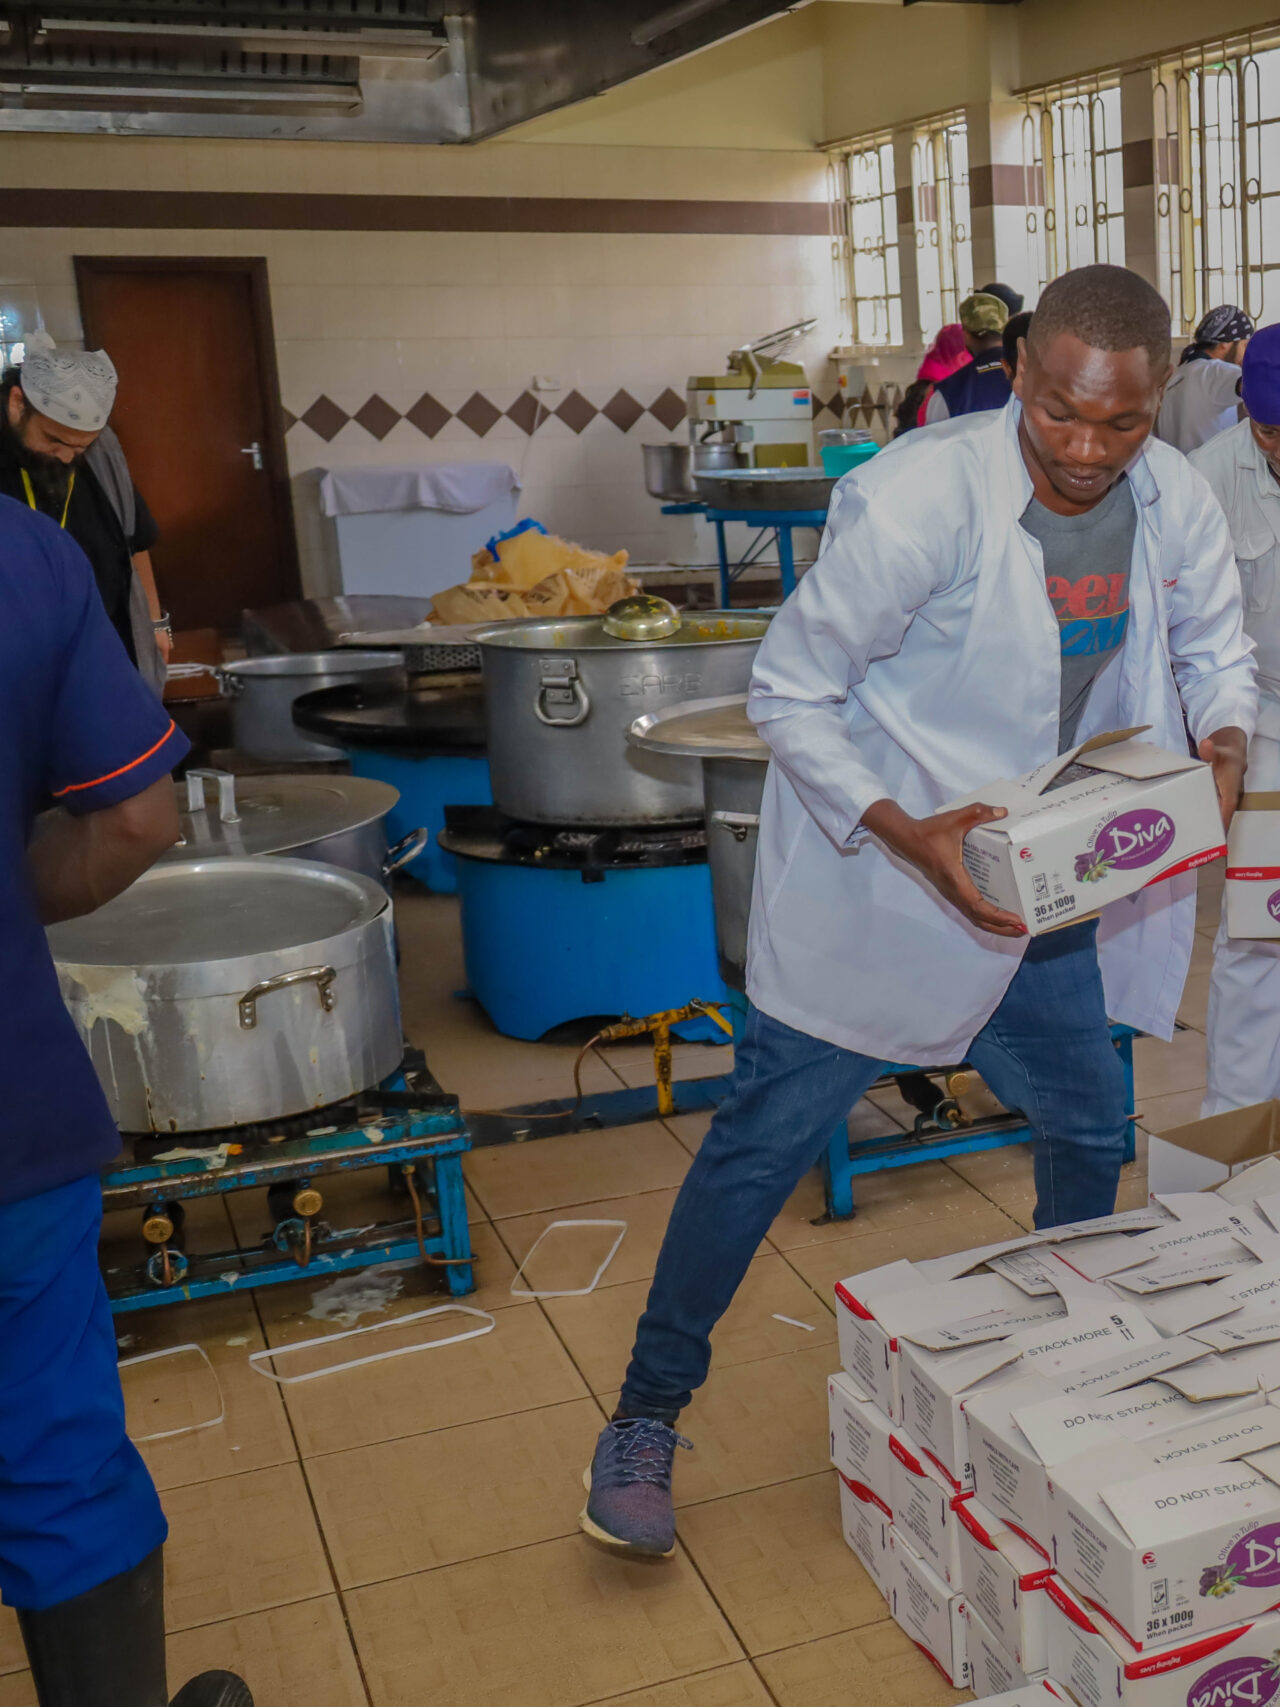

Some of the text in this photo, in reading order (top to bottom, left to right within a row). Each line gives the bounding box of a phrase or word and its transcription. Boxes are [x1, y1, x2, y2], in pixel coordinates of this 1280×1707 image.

[1102, 809, 1118, 826] Tulip
[1109, 815, 1171, 857] Diva
[1034, 904, 1047, 917] 36
[1054, 893, 1076, 910] 100g
[1036, 904, 1077, 924] When packed
[1158, 1216, 1242, 1250] STACK MORE 5
[1238, 1280, 1280, 1300] STACK
[1027, 1315, 1124, 1357] STACK MORE 5
[1076, 1350, 1173, 1389] DO NOT STACK
[1063, 1399, 1161, 1429] DO STACK
[1160, 1424, 1263, 1462] DO NOT STACK
[1154, 1479, 1261, 1510] DO NOT STACK
[1239, 1520, 1260, 1536] Tulip
[1146, 1620, 1193, 1640] When packed
[1147, 1618, 1160, 1632] 36
[1169, 1610, 1194, 1626] 100g
[1192, 1672, 1265, 1707] Diva
